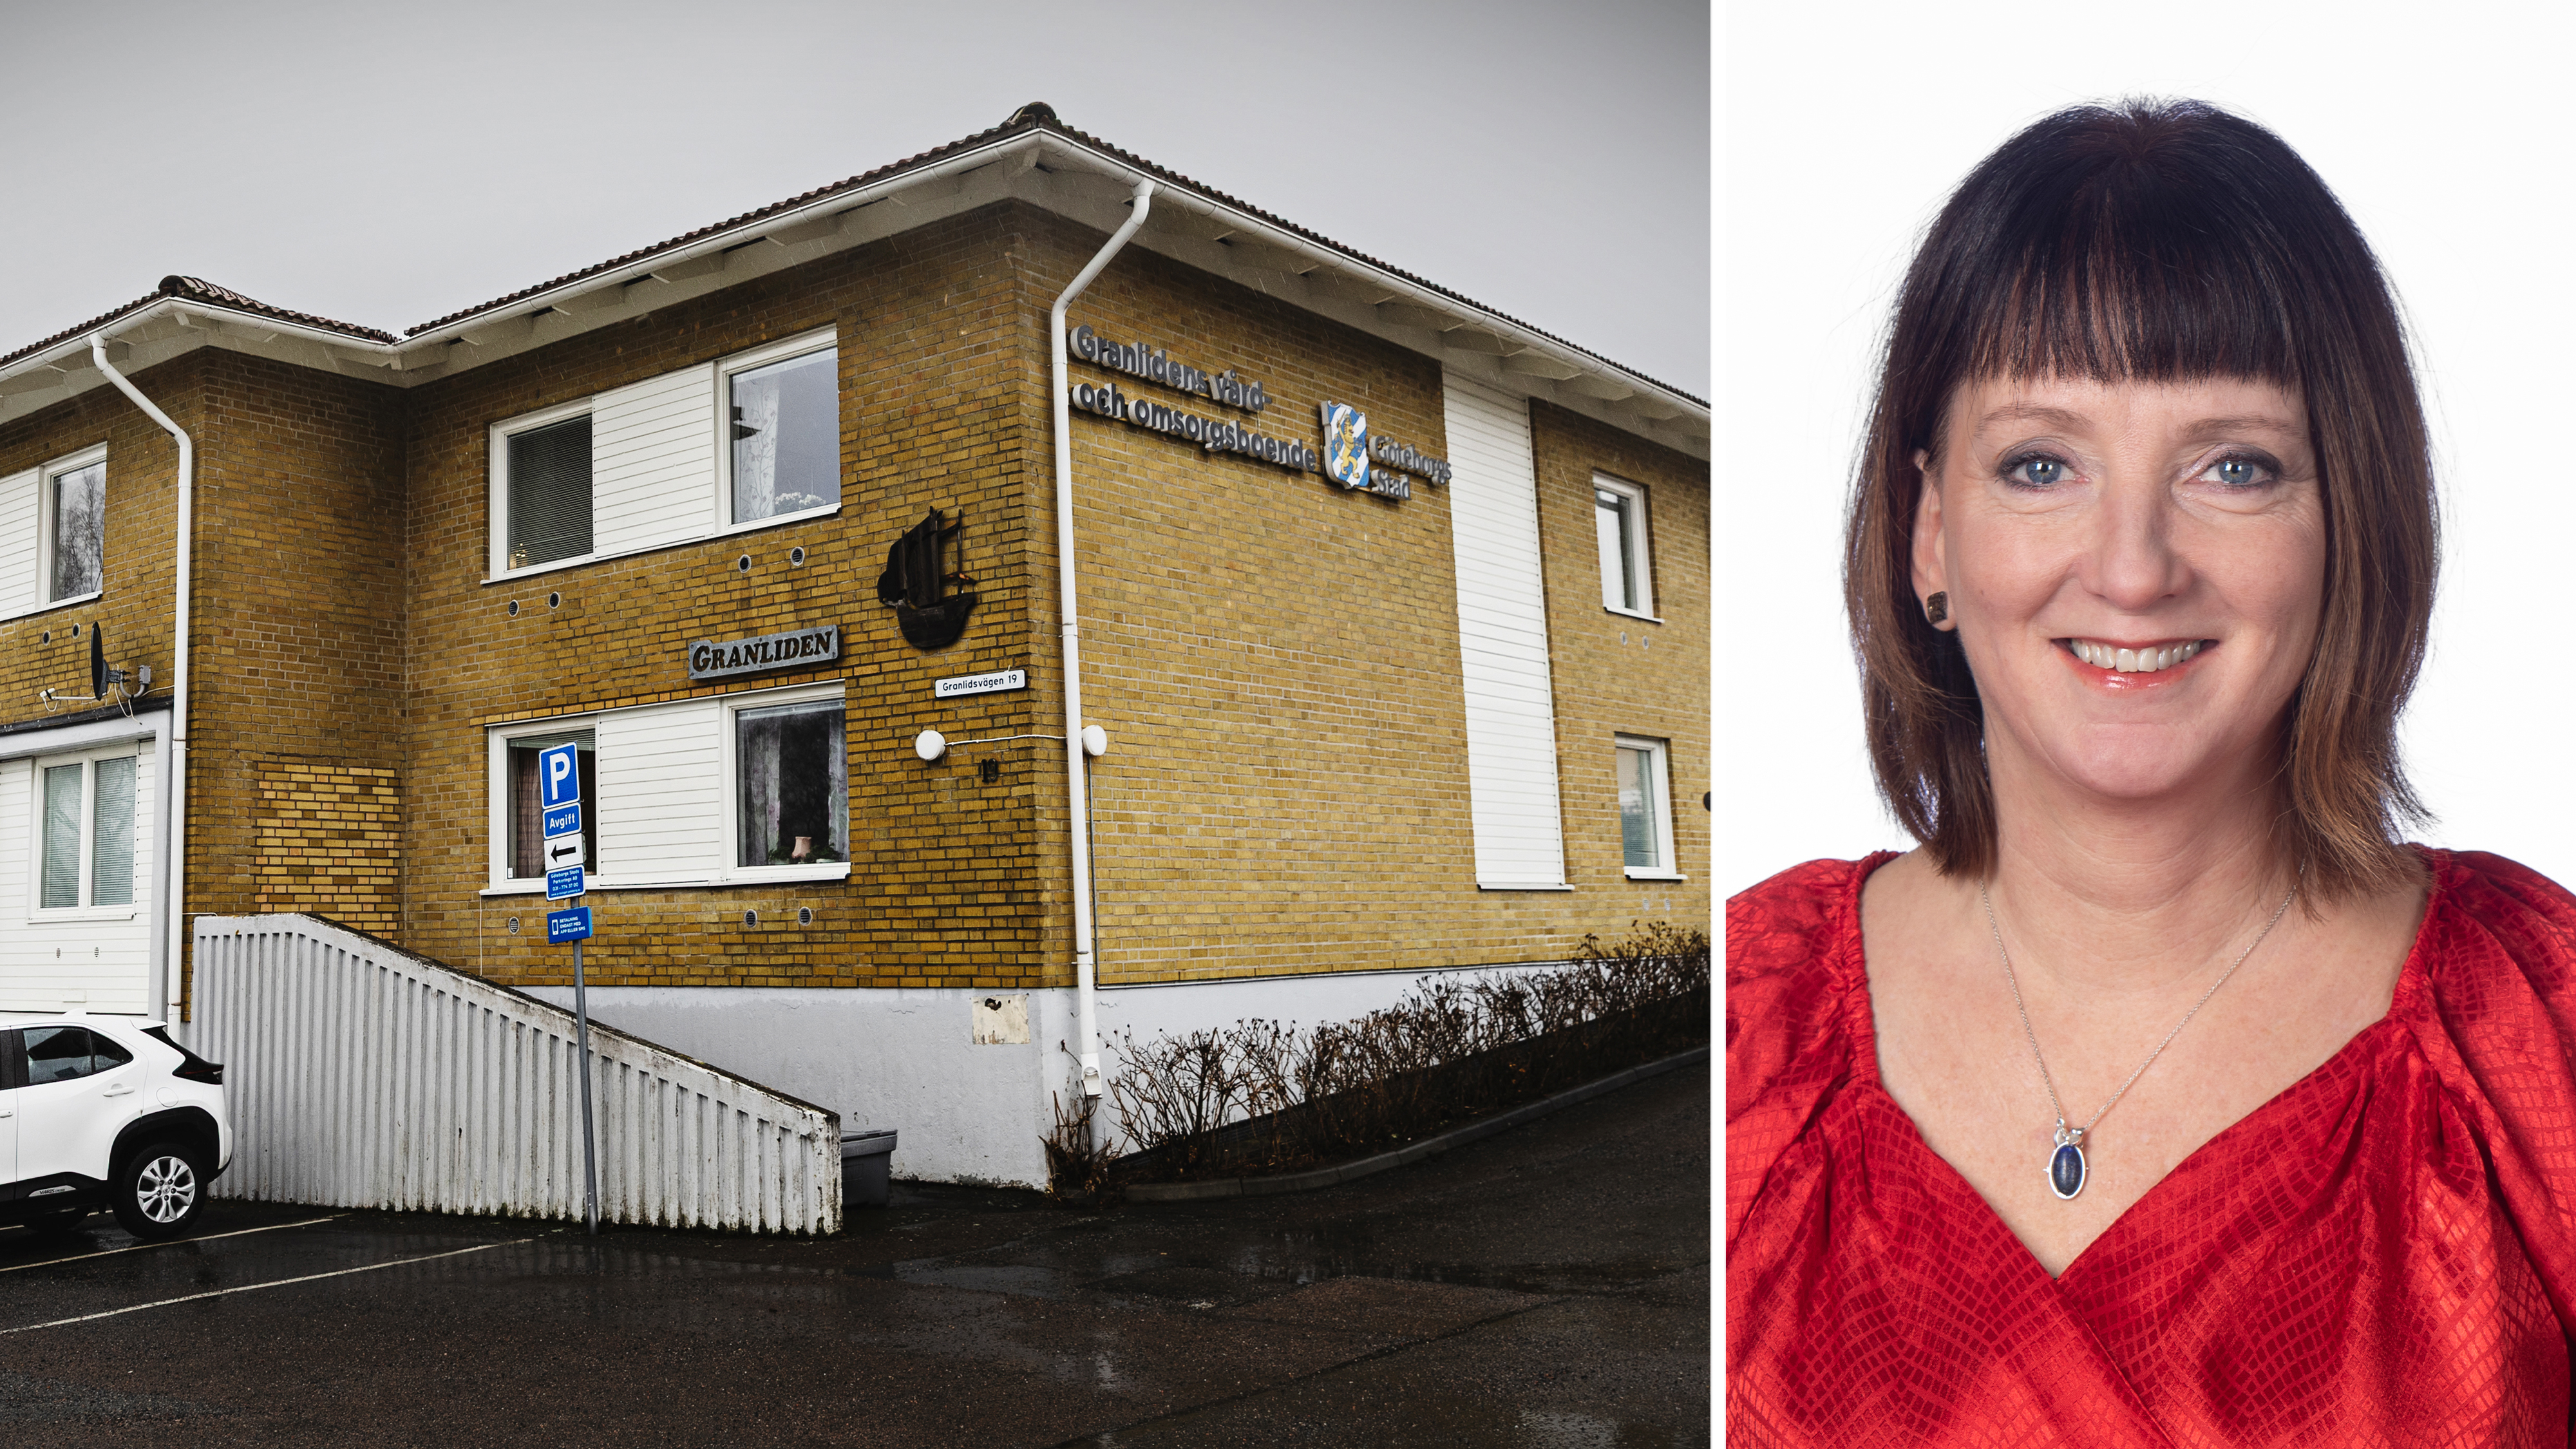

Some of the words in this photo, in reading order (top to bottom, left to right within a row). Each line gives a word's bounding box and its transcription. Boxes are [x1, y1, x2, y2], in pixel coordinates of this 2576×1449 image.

[1070, 325, 1207, 393] Granlidens
[1209, 369, 1272, 411] vård-
[1073, 383, 1125, 419] och
[1128, 399, 1316, 473] omsorgsboende
[1369, 435, 1452, 485] Göteborgs
[1371, 469, 1412, 500] Stad
[943, 677, 1004, 691] Granlidsvägen
[1008, 674, 1018, 684] 19
[549, 752, 571, 800] P
[981, 758, 998, 783] 19
[549, 813, 575, 829] Avgift
